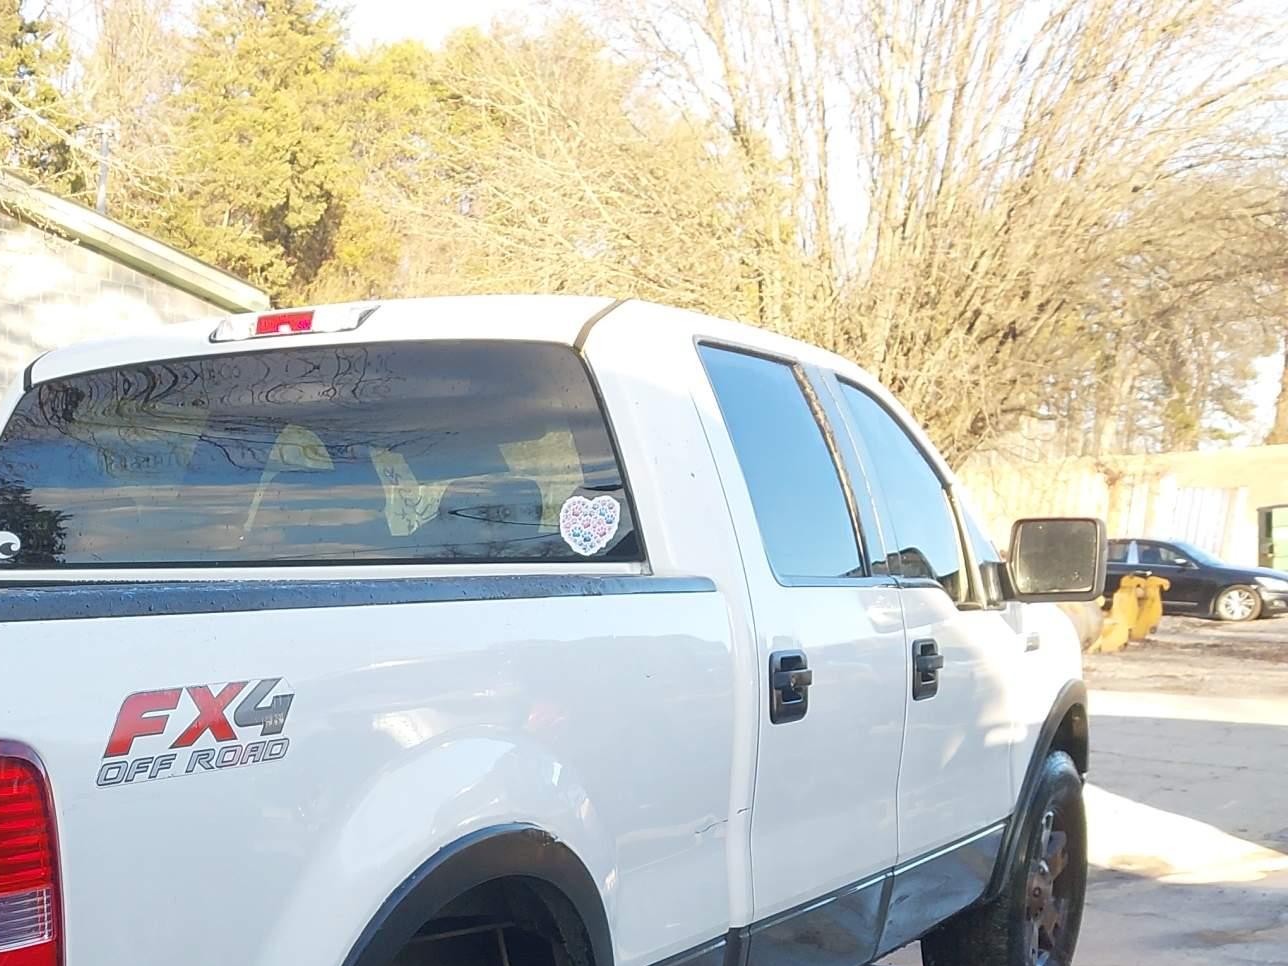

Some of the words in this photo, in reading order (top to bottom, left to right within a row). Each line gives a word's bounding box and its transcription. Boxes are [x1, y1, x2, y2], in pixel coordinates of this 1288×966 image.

[103, 677, 295, 758] FX4
[96, 753, 177, 786] OFF
[185, 737, 290, 773] ROAD
